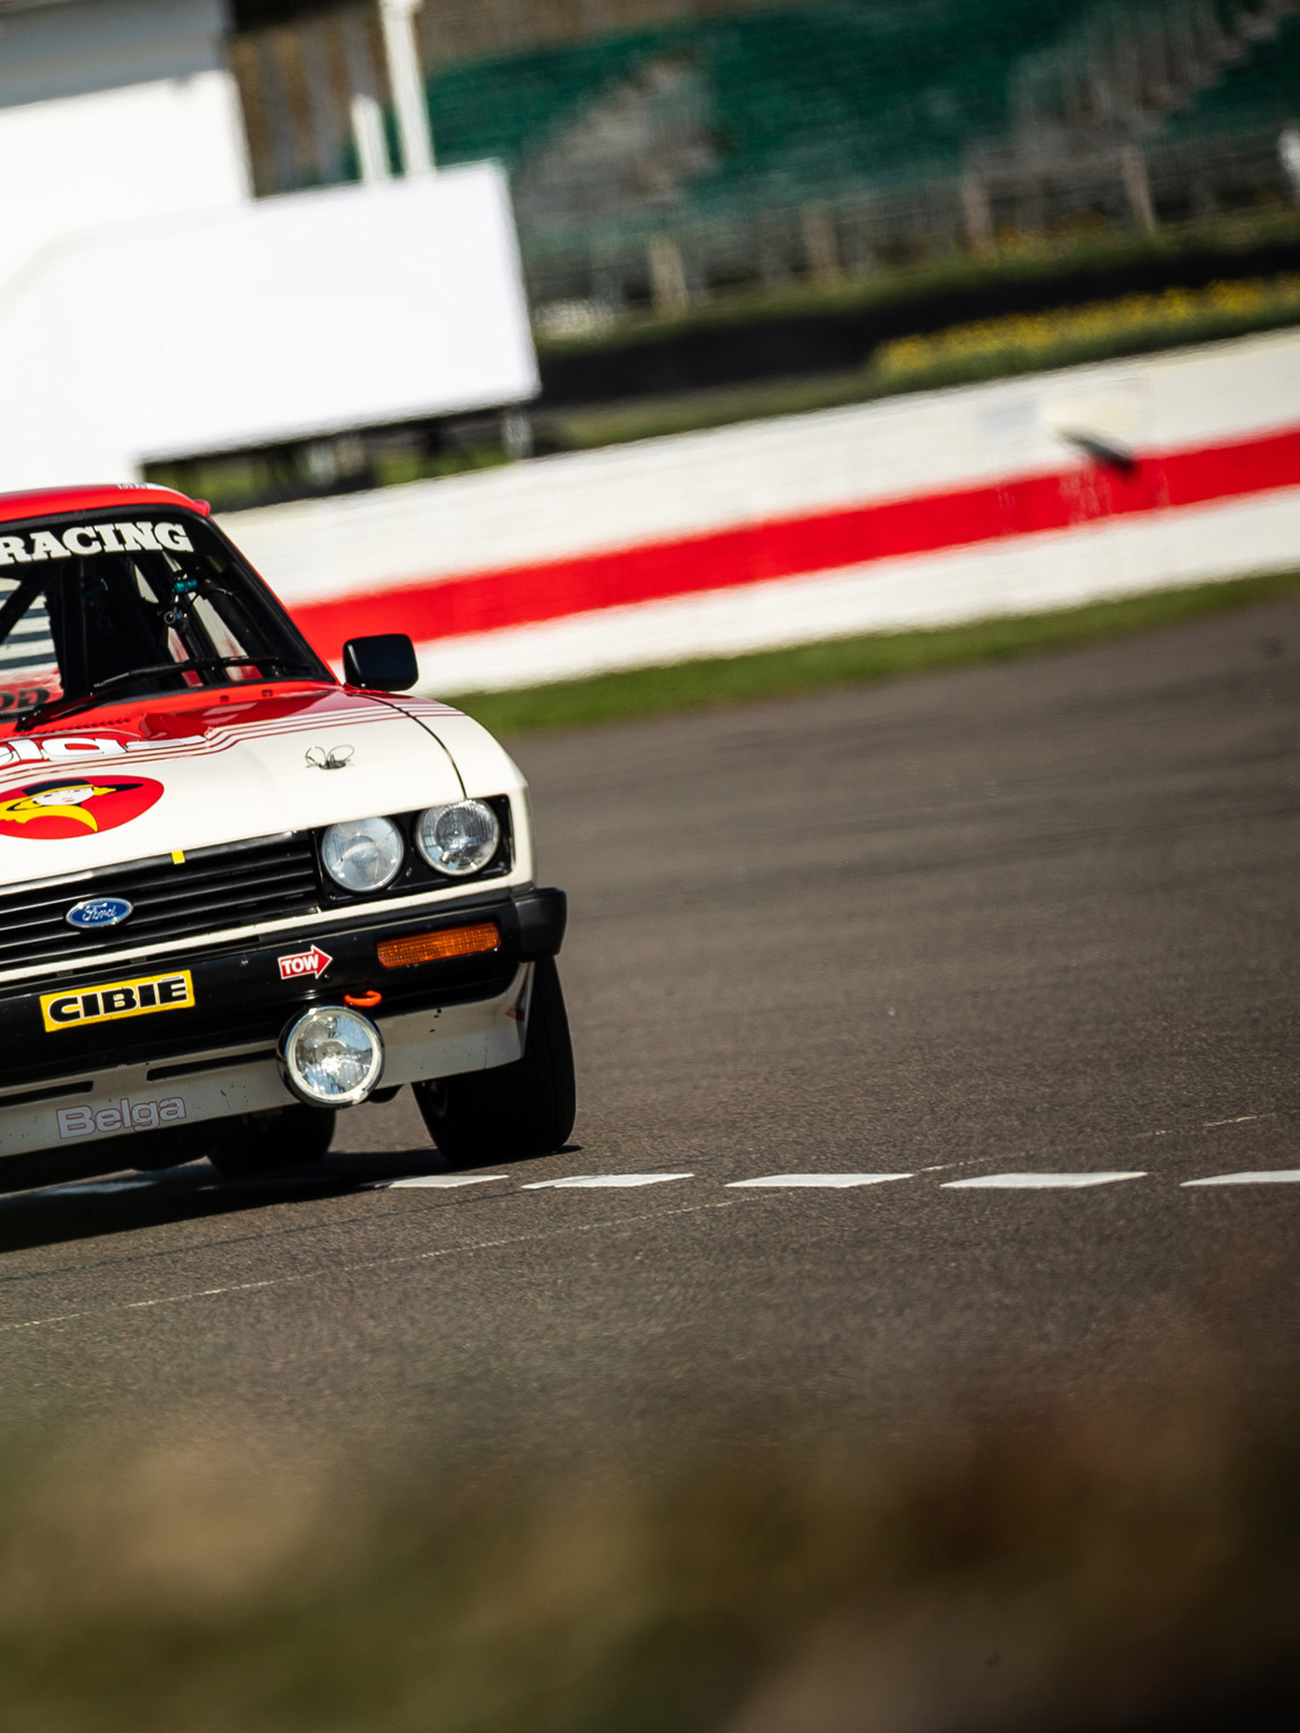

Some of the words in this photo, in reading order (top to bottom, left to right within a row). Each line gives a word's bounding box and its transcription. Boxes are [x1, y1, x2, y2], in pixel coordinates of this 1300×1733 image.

[82, 902, 117, 922] Ford
[281, 955, 319, 974] TOW
[56, 1096, 187, 1139] Belga
